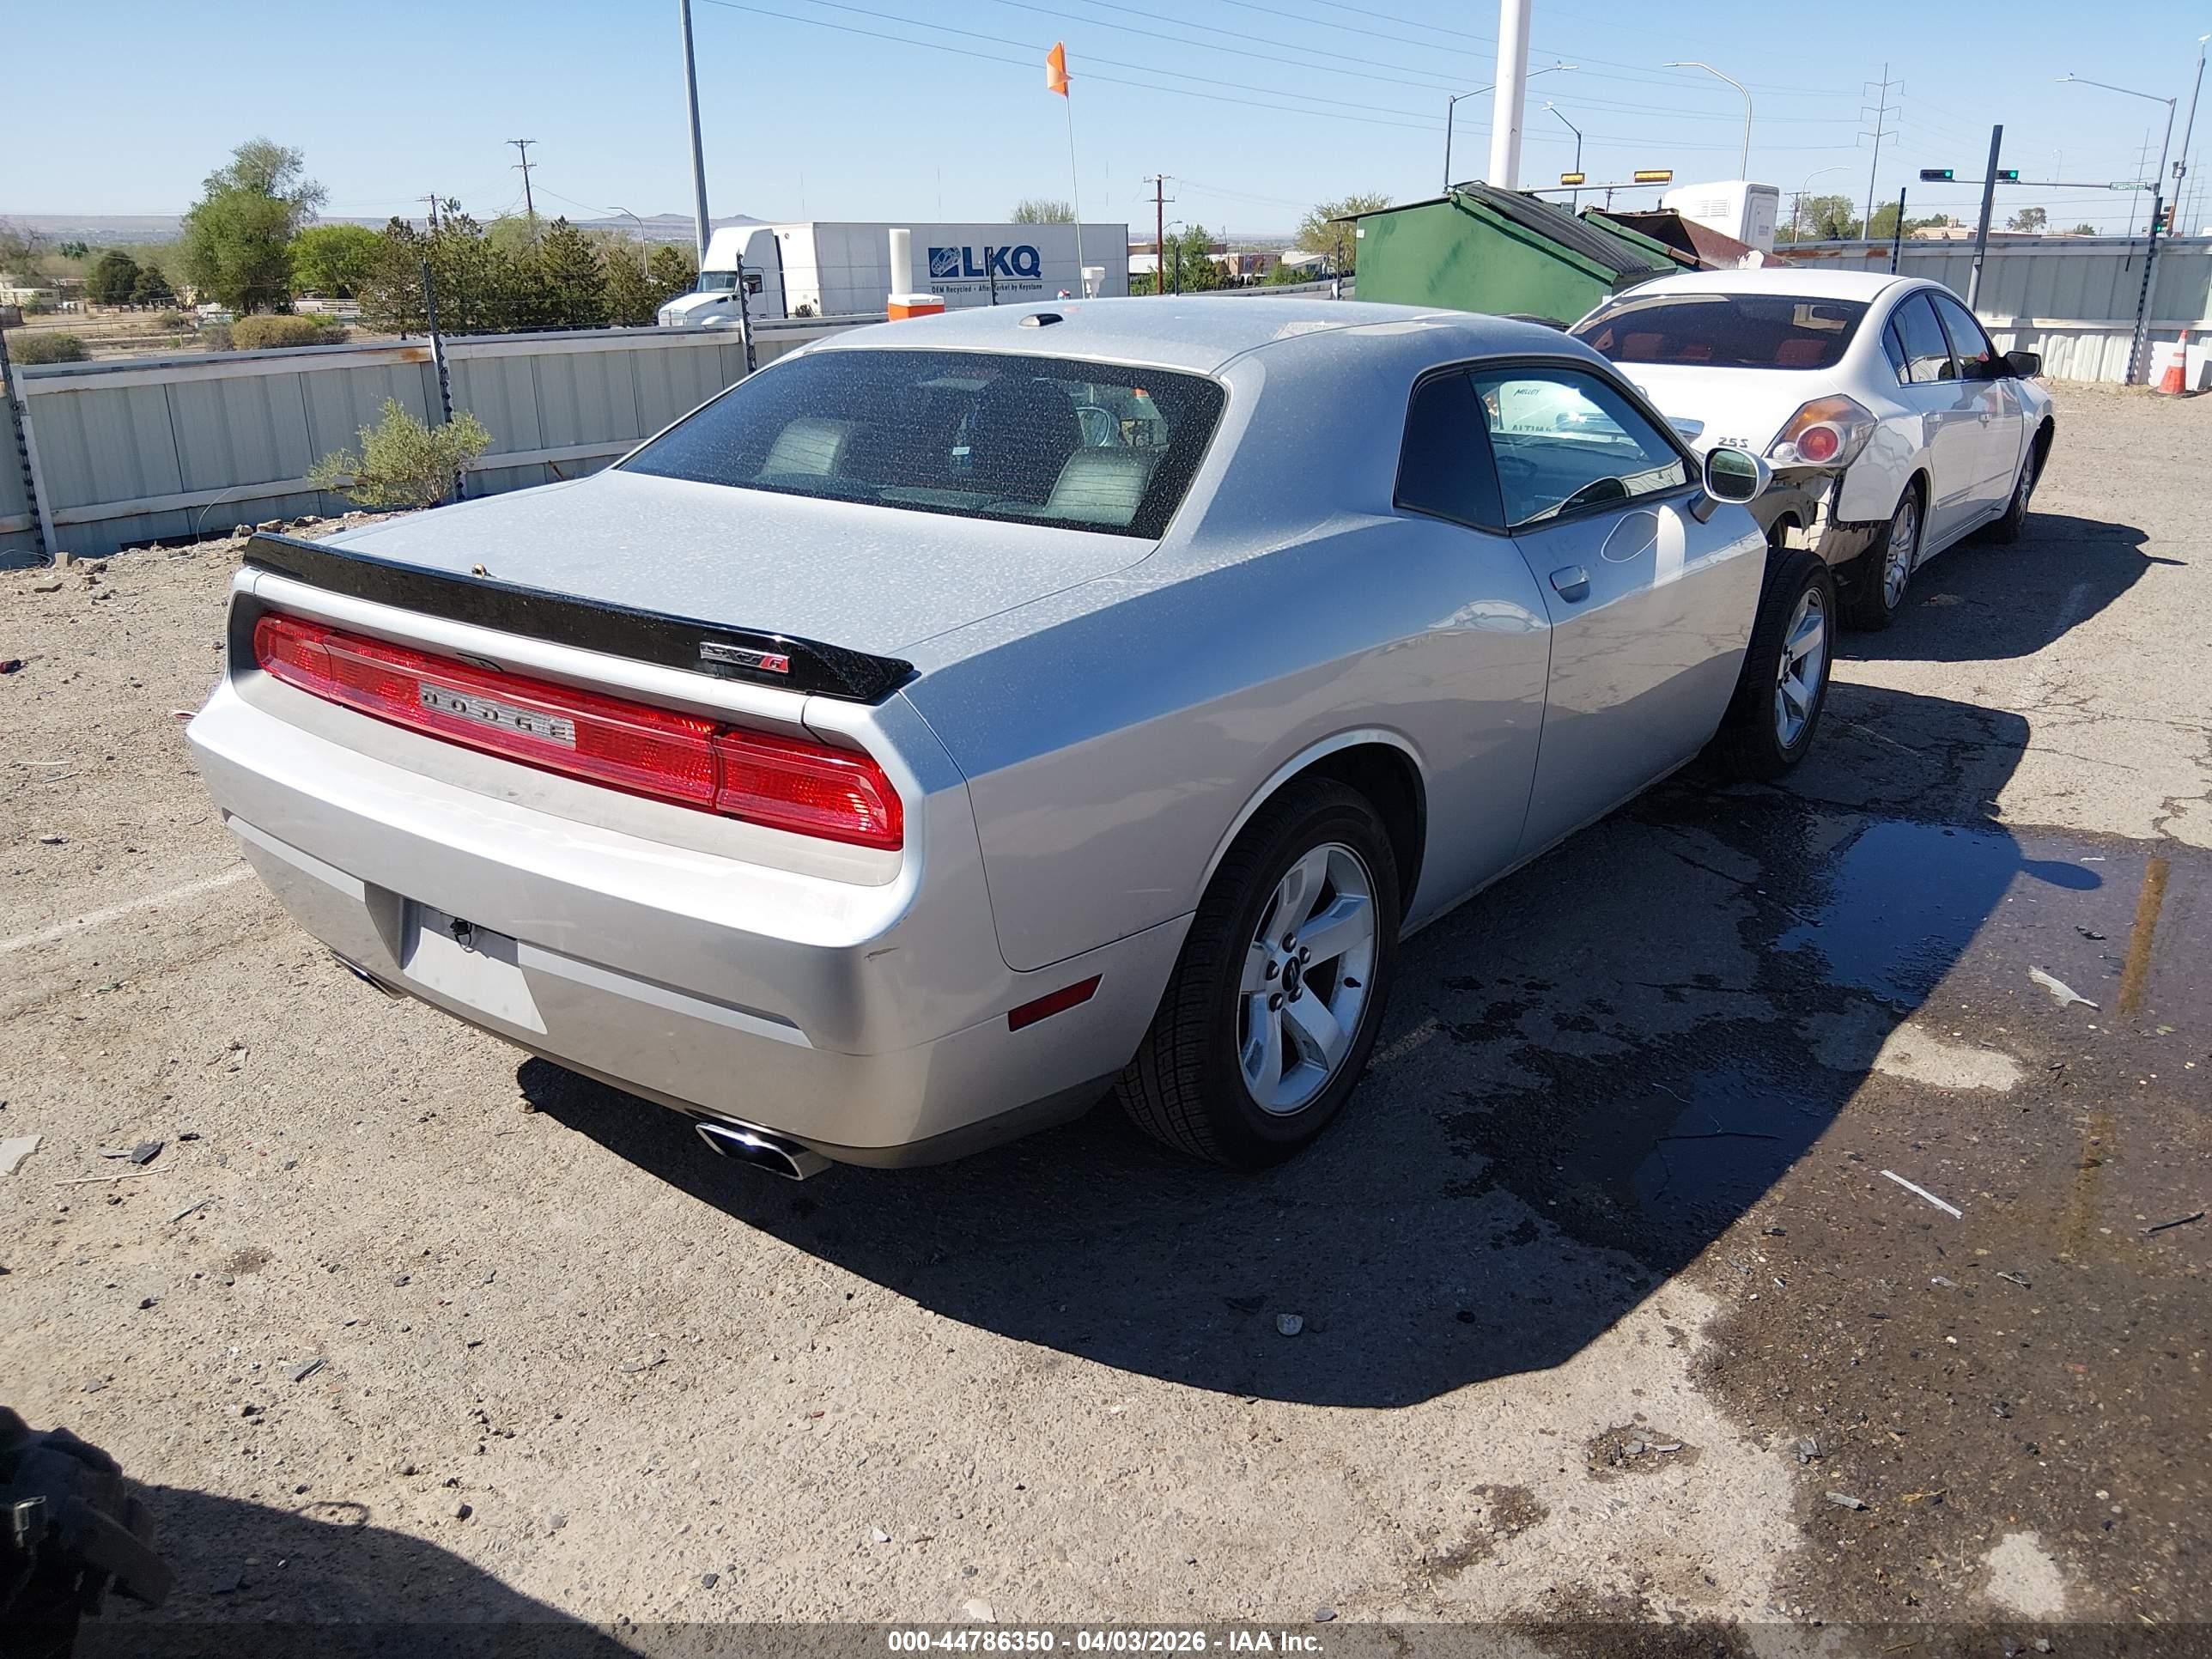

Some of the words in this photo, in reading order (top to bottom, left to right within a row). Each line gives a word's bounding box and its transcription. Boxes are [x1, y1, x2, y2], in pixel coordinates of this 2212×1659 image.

[962, 245, 1042, 278] LKQ
[946, 285, 971, 294] Recycled
[422, 690, 568, 741] DODGE
